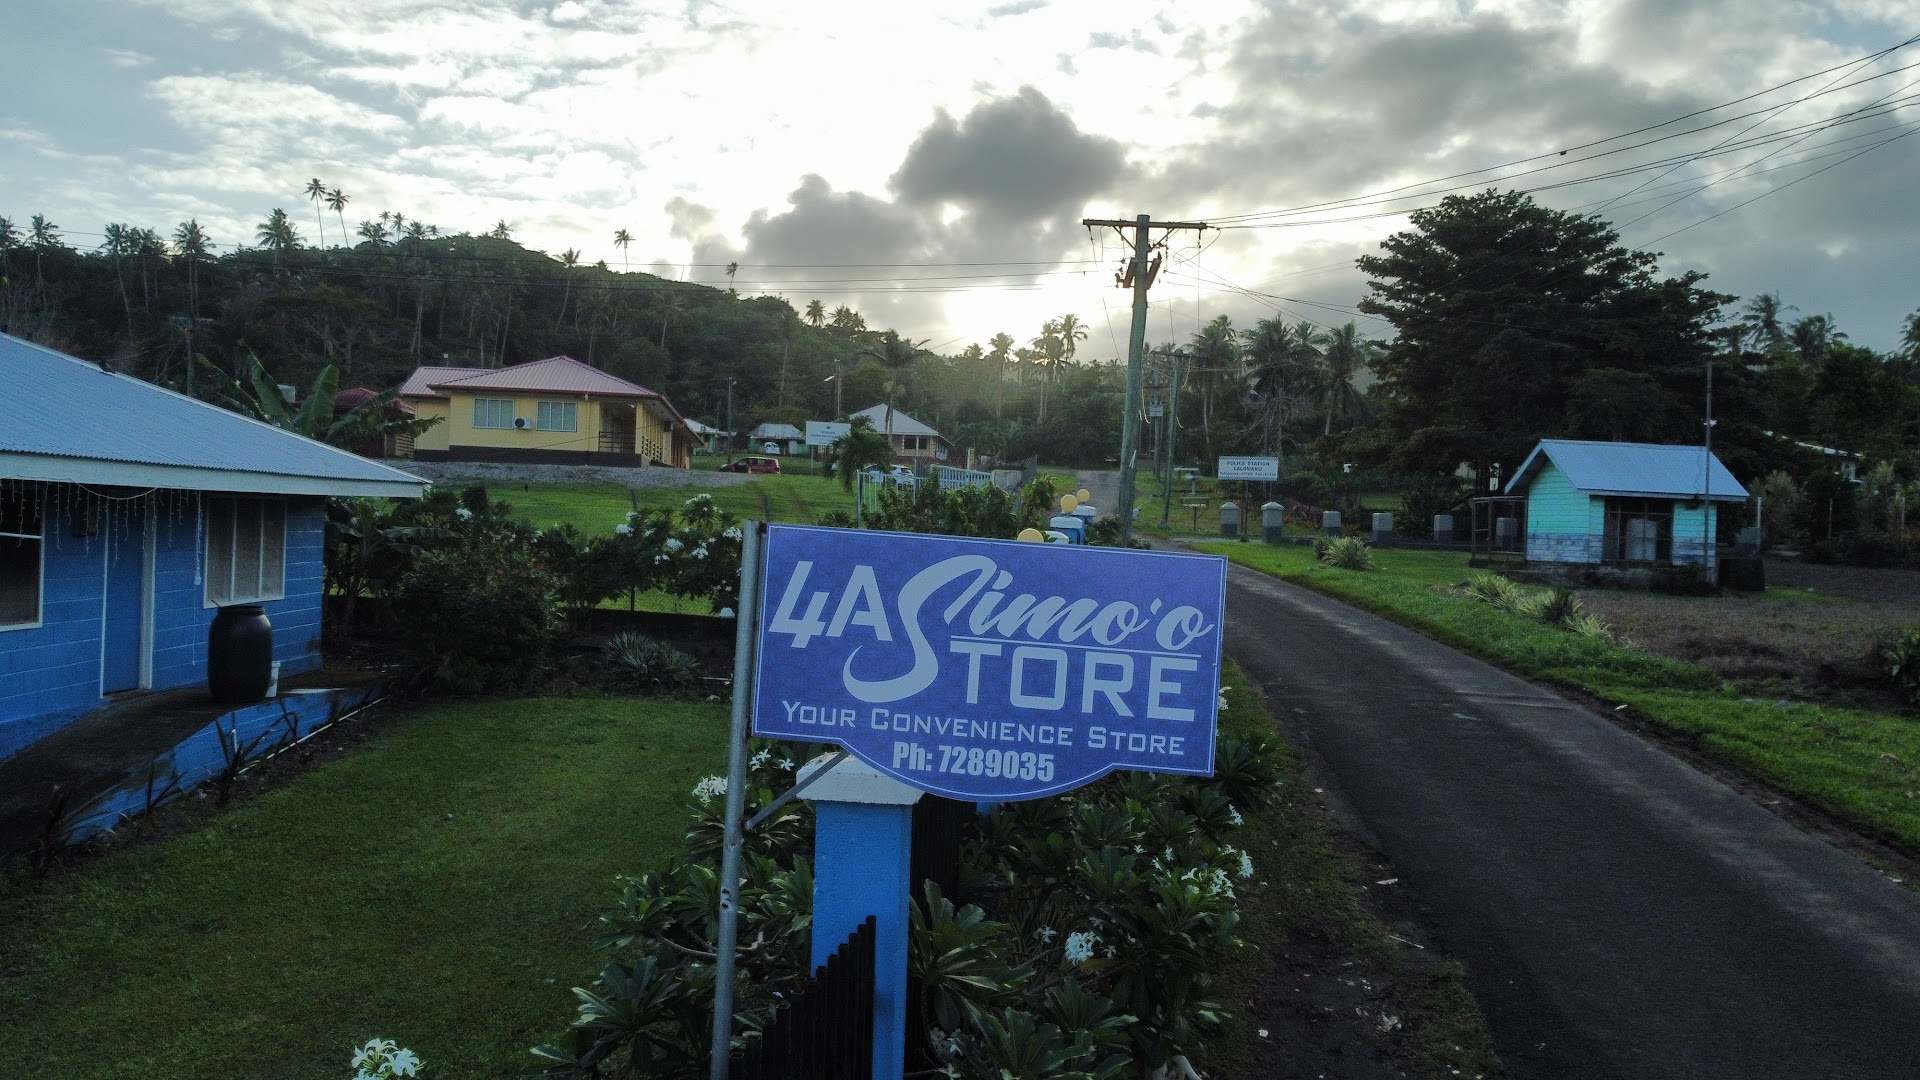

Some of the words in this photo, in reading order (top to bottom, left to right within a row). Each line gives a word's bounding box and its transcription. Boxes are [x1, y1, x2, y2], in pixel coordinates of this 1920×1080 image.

[950, 641, 1198, 722] STORE
[892, 741, 932, 772] Ph:
[938, 744, 1055, 782] 7289035
